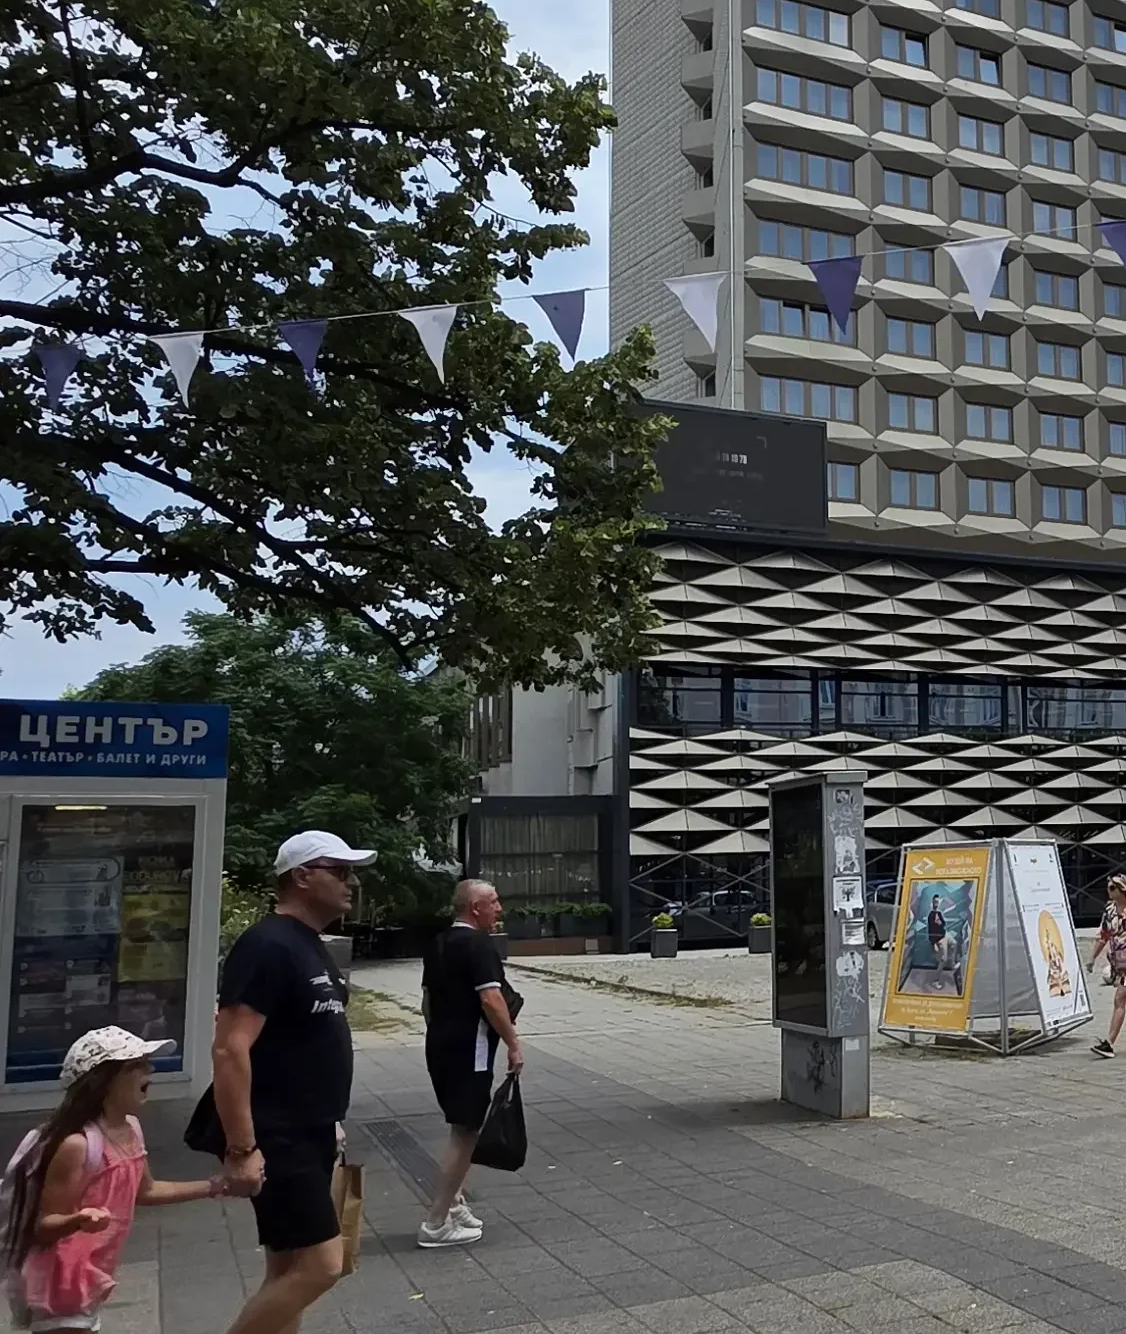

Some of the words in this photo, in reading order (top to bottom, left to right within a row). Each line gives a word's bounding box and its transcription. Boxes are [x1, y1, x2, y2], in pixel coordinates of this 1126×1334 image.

[18, 713, 209, 748] ЦЕНТЪР
[31, 751, 85, 764] ТЕАТЪР
[96, 752, 141, 765] БАЛЕТ
[145, 753, 156, 765] И
[160, 754, 207, 767] ДРУГИ
